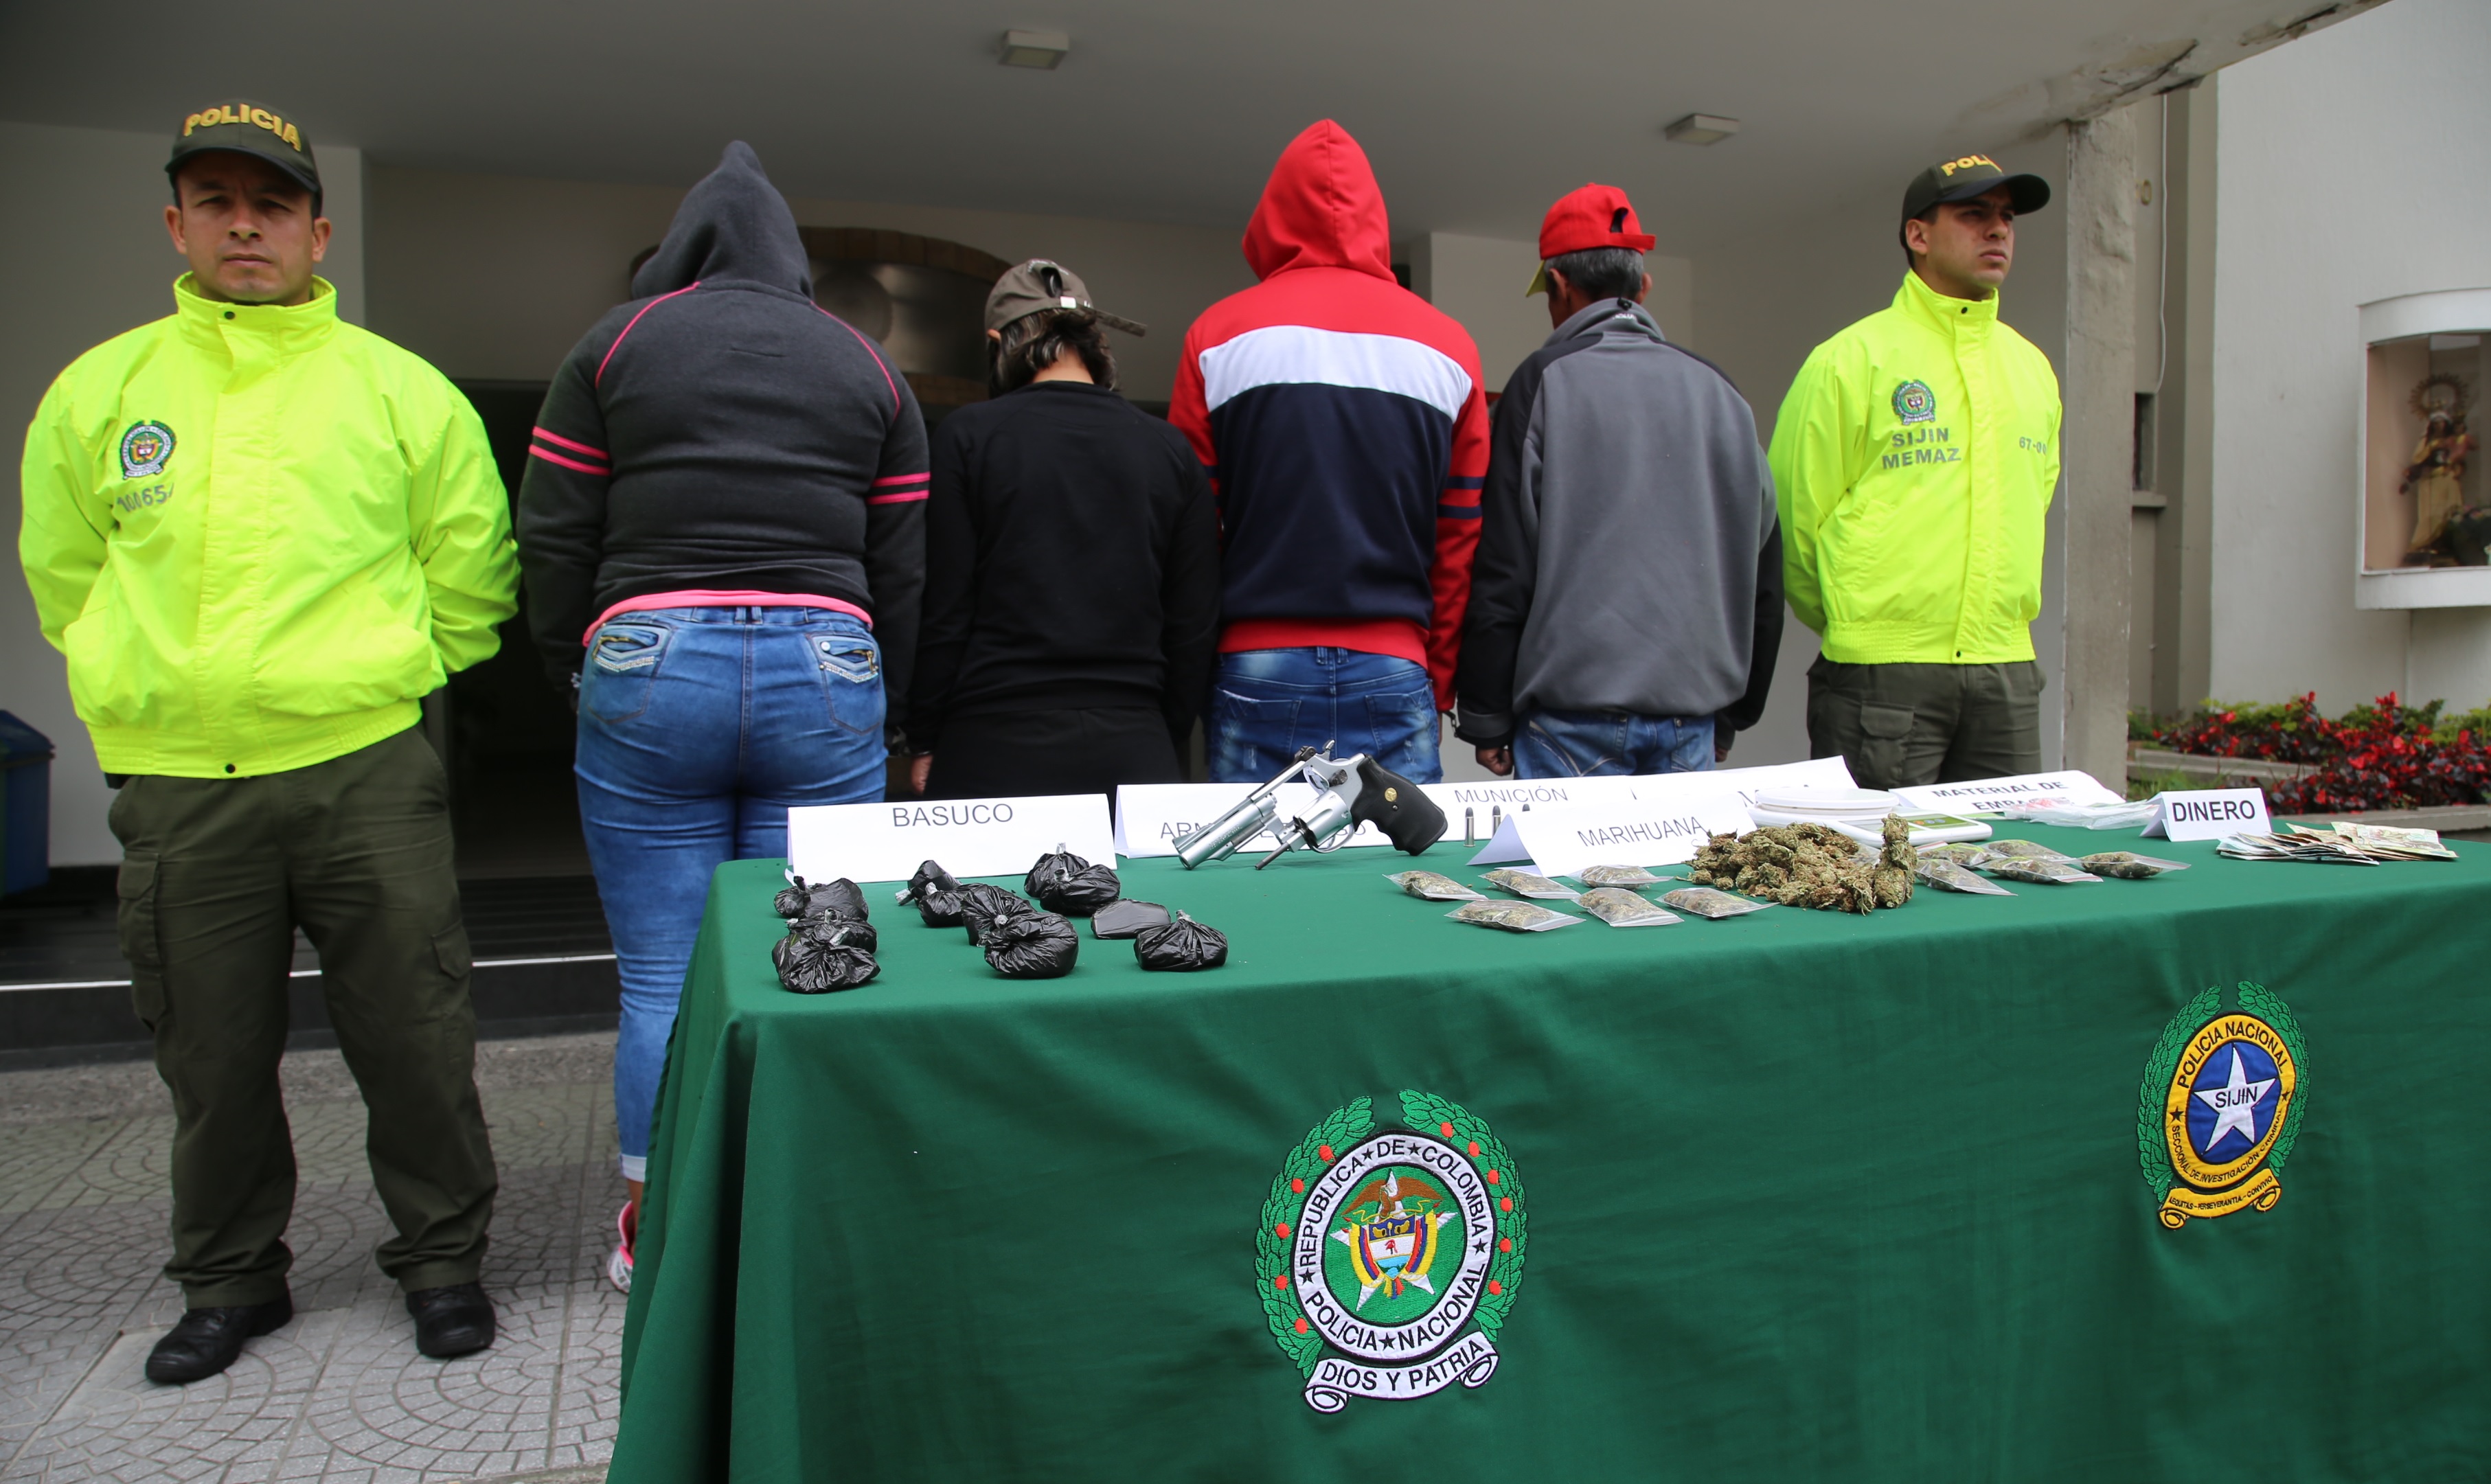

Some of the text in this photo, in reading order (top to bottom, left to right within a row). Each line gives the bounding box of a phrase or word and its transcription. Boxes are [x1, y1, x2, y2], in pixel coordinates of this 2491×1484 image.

[183, 103, 301, 152] POLICIA
[1891, 428, 1949, 448] SIJIN
[1882, 448, 1961, 470] MEMAZ
[1454, 786, 1569, 803] MUNICIÓN
[1931, 781, 2069, 797] MATERIAL DE
[892, 803, 1013, 827] BASUCO
[2172, 799, 2255, 823] DINERO
[1577, 816, 1708, 847] MARIHUANA
[2177, 1021, 2289, 1088] POLICIA NACIONAL
[2215, 1086, 2258, 1108] SIJIN
[2172, 1125, 2191, 1175] SECCIONAL
[2189, 1169, 2201, 1180] DE
[1299, 1139, 1489, 1267] REPUBLICA DE COLOMBIA
[1305, 1263, 1486, 1351] POLICIA NACIONAL
[1321, 1339, 1485, 1391] DIOS Y PATRIA
